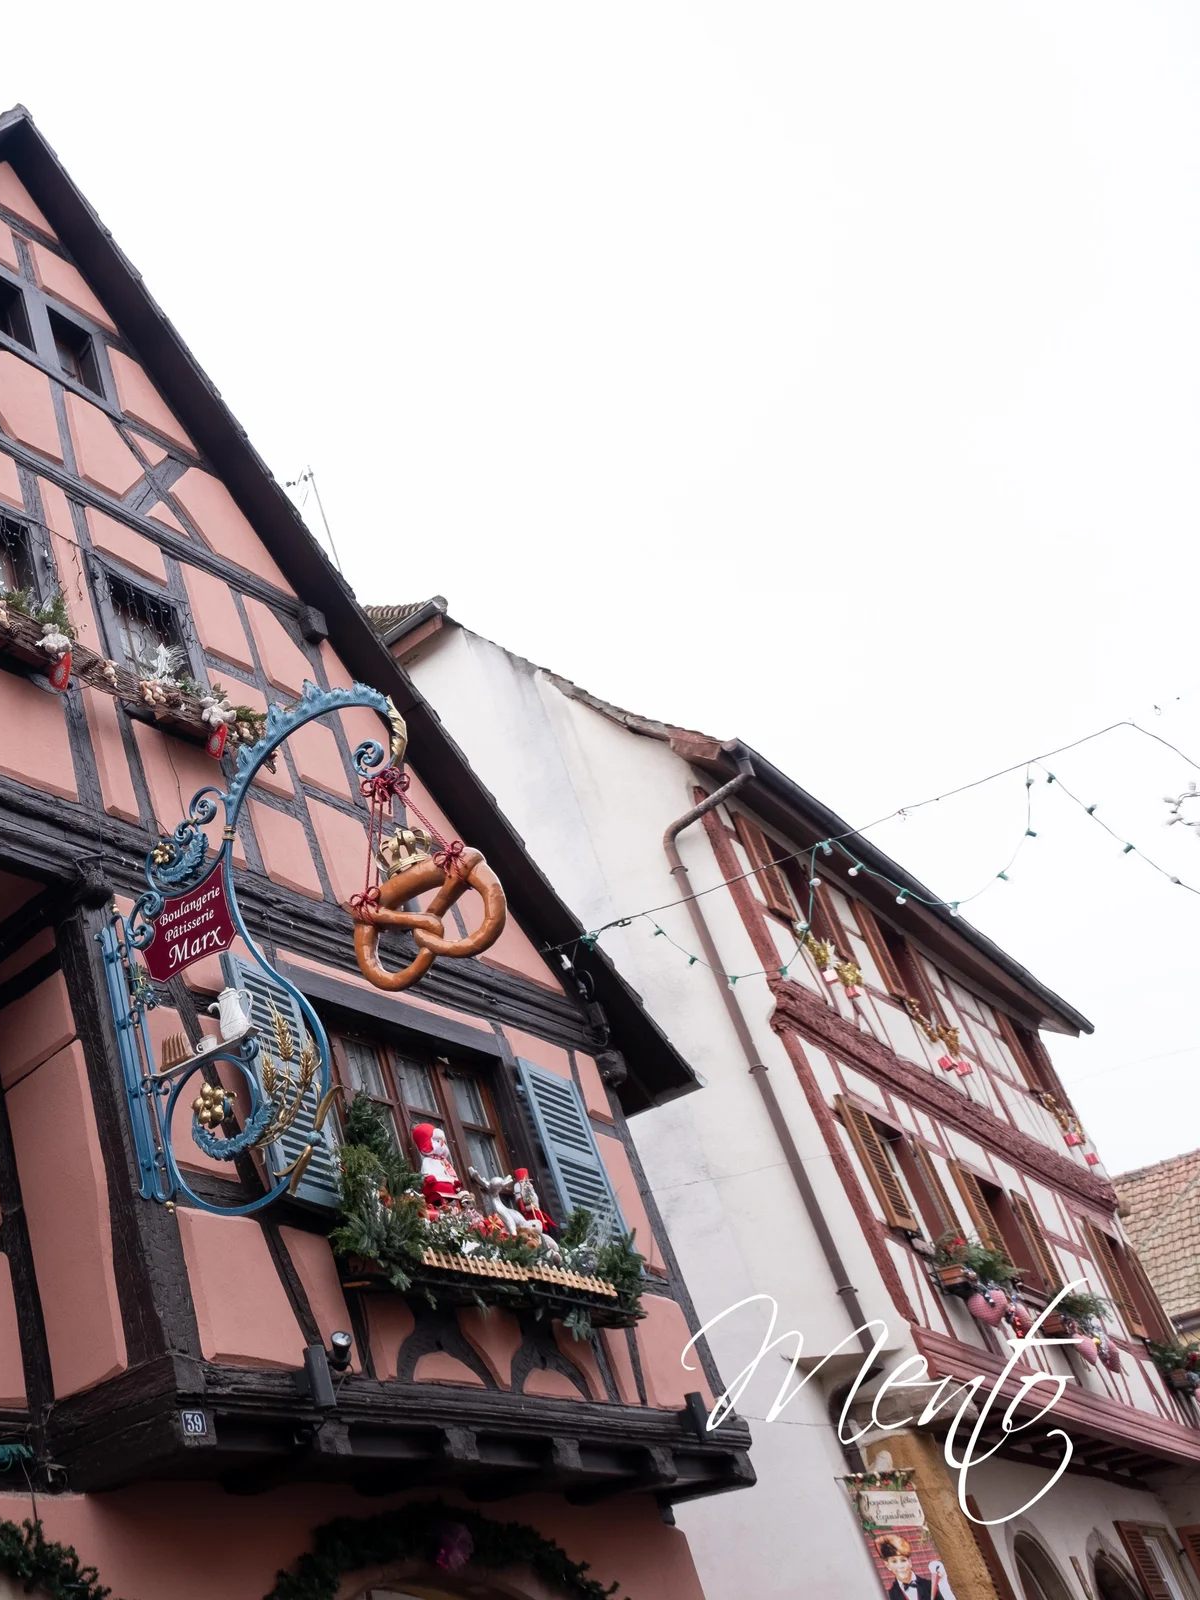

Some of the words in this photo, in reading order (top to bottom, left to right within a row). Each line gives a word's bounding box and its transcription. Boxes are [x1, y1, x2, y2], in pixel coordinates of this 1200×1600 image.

[160, 886, 220, 926] Boulangerie
[165, 909, 214, 942] Pâtisserie
[169, 926, 225, 968] Marx
[185, 1414, 202, 1432] 39
[864, 1494, 898, 1511] Joyeuses
